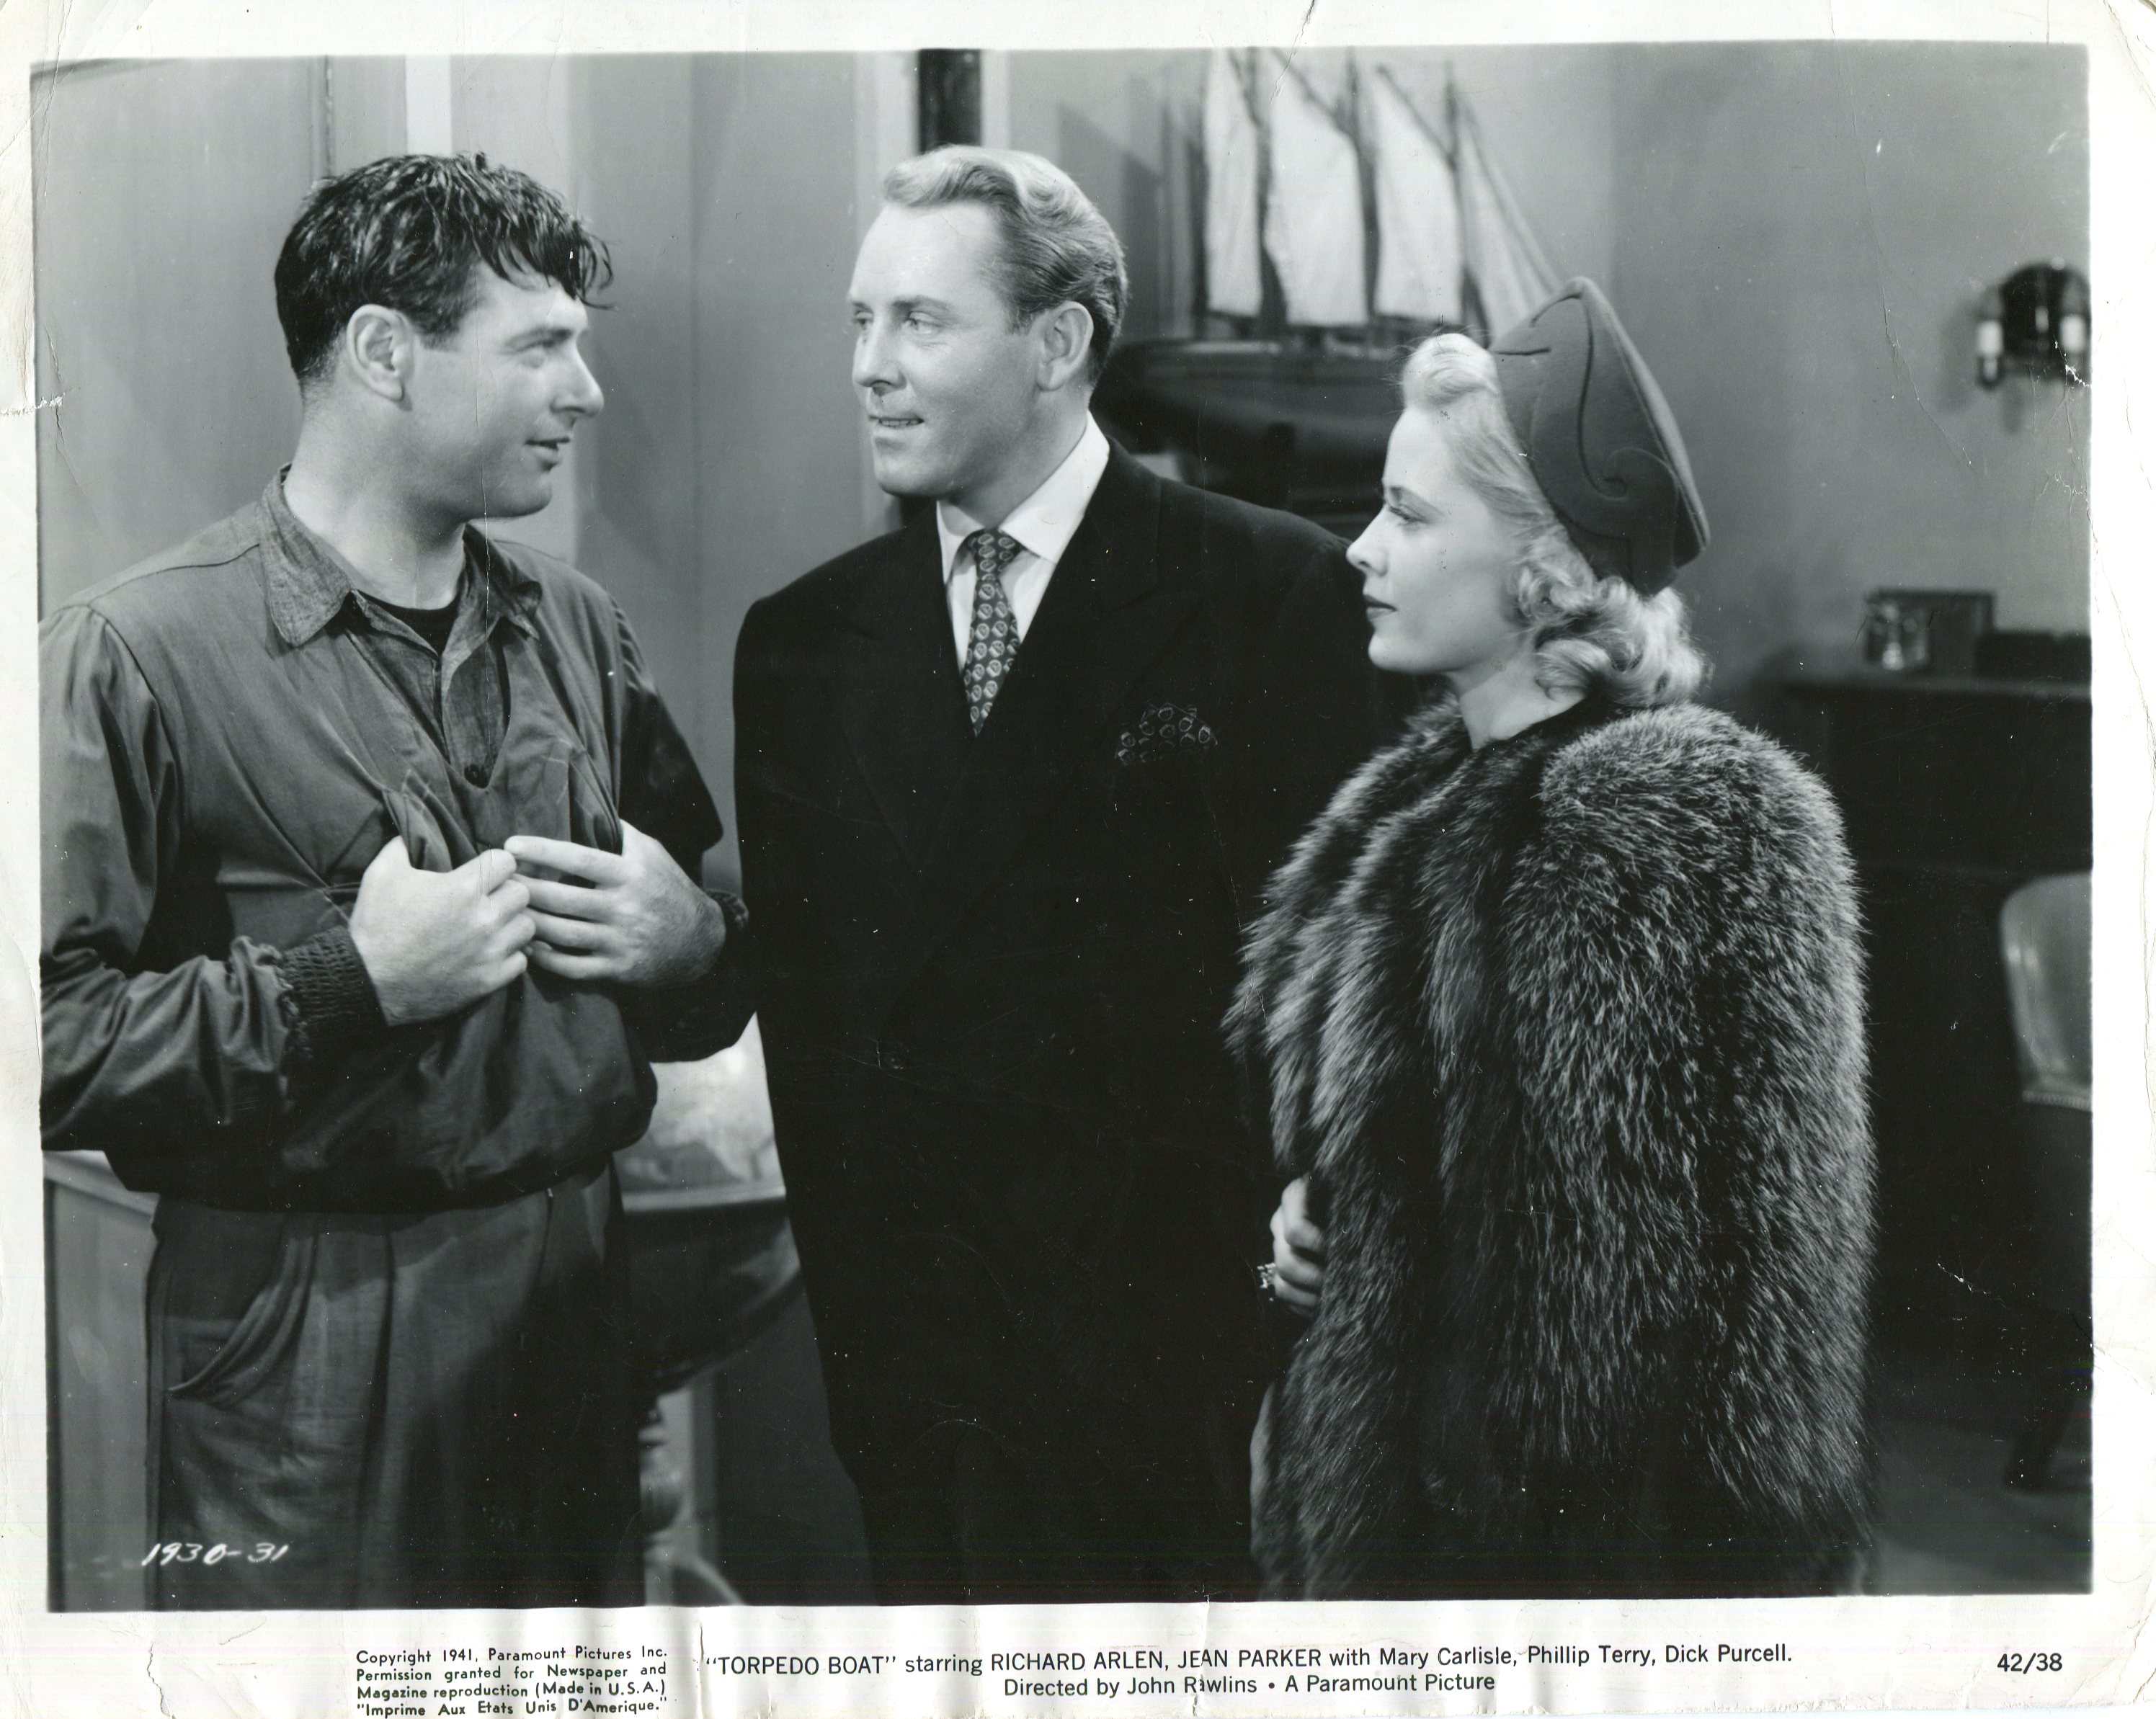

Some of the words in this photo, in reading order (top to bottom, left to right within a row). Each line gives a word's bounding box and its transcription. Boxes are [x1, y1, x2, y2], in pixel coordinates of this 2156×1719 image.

[141, 1542, 288, 1565] 1930-31
[356, 1649, 432, 1666] Copyright
[443, 1649, 478, 1662] 1941,
[489, 1648, 566, 1661] Paramount
[575, 1645, 632, 1659] Pictures
[641, 1646, 667, 1658] Inc.
[905, 1653, 983, 1676] starring
[992, 1653, 1085, 1671] RICHARD
[1093, 1651, 1169, 1671] ARLEN,
[1177, 1649, 1228, 1669] JEAN
[1239, 1648, 1322, 1667] PARKER
[1329, 1648, 1370, 1666] with
[1380, 1648, 1429, 1669] Mary
[1438, 1646, 1517, 1667] Carlisle,
[1528, 1646, 1590, 1667] Phillip
[1598, 1645, 1656, 1667] Terry,
[1665, 1644, 1709, 1663] Dick
[1718, 1643, 1792, 1662] Purcell.
[1997, 1653, 2063, 1674] 42/38
[357, 1669, 432, 1682] Permission
[444, 1665, 501, 1684] granted
[514, 1666, 535, 1679] for
[547, 1664, 628, 1681] Newspaper
[640, 1661, 666, 1676] and
[357, 1686, 427, 1702] Magazine
[434, 1684, 527, 1701] reproduction
[535, 1680, 584, 1699] (Made
[589, 1682, 602, 1695] in
[1004, 1678, 1087, 1696] Directed
[1097, 1678, 1120, 1698] by
[1127, 1676, 1175, 1695] John
[1285, 1675, 1298, 1692] A
[1307, 1674, 1417, 1692] Paramount
[1425, 1674, 1495, 1692] Picture
[357, 1703, 426, 1719] "Imprime
[437, 1704, 466, 1716] Aux
[478, 1700, 514, 1715] Etats
[525, 1701, 556, 1715] Unis
